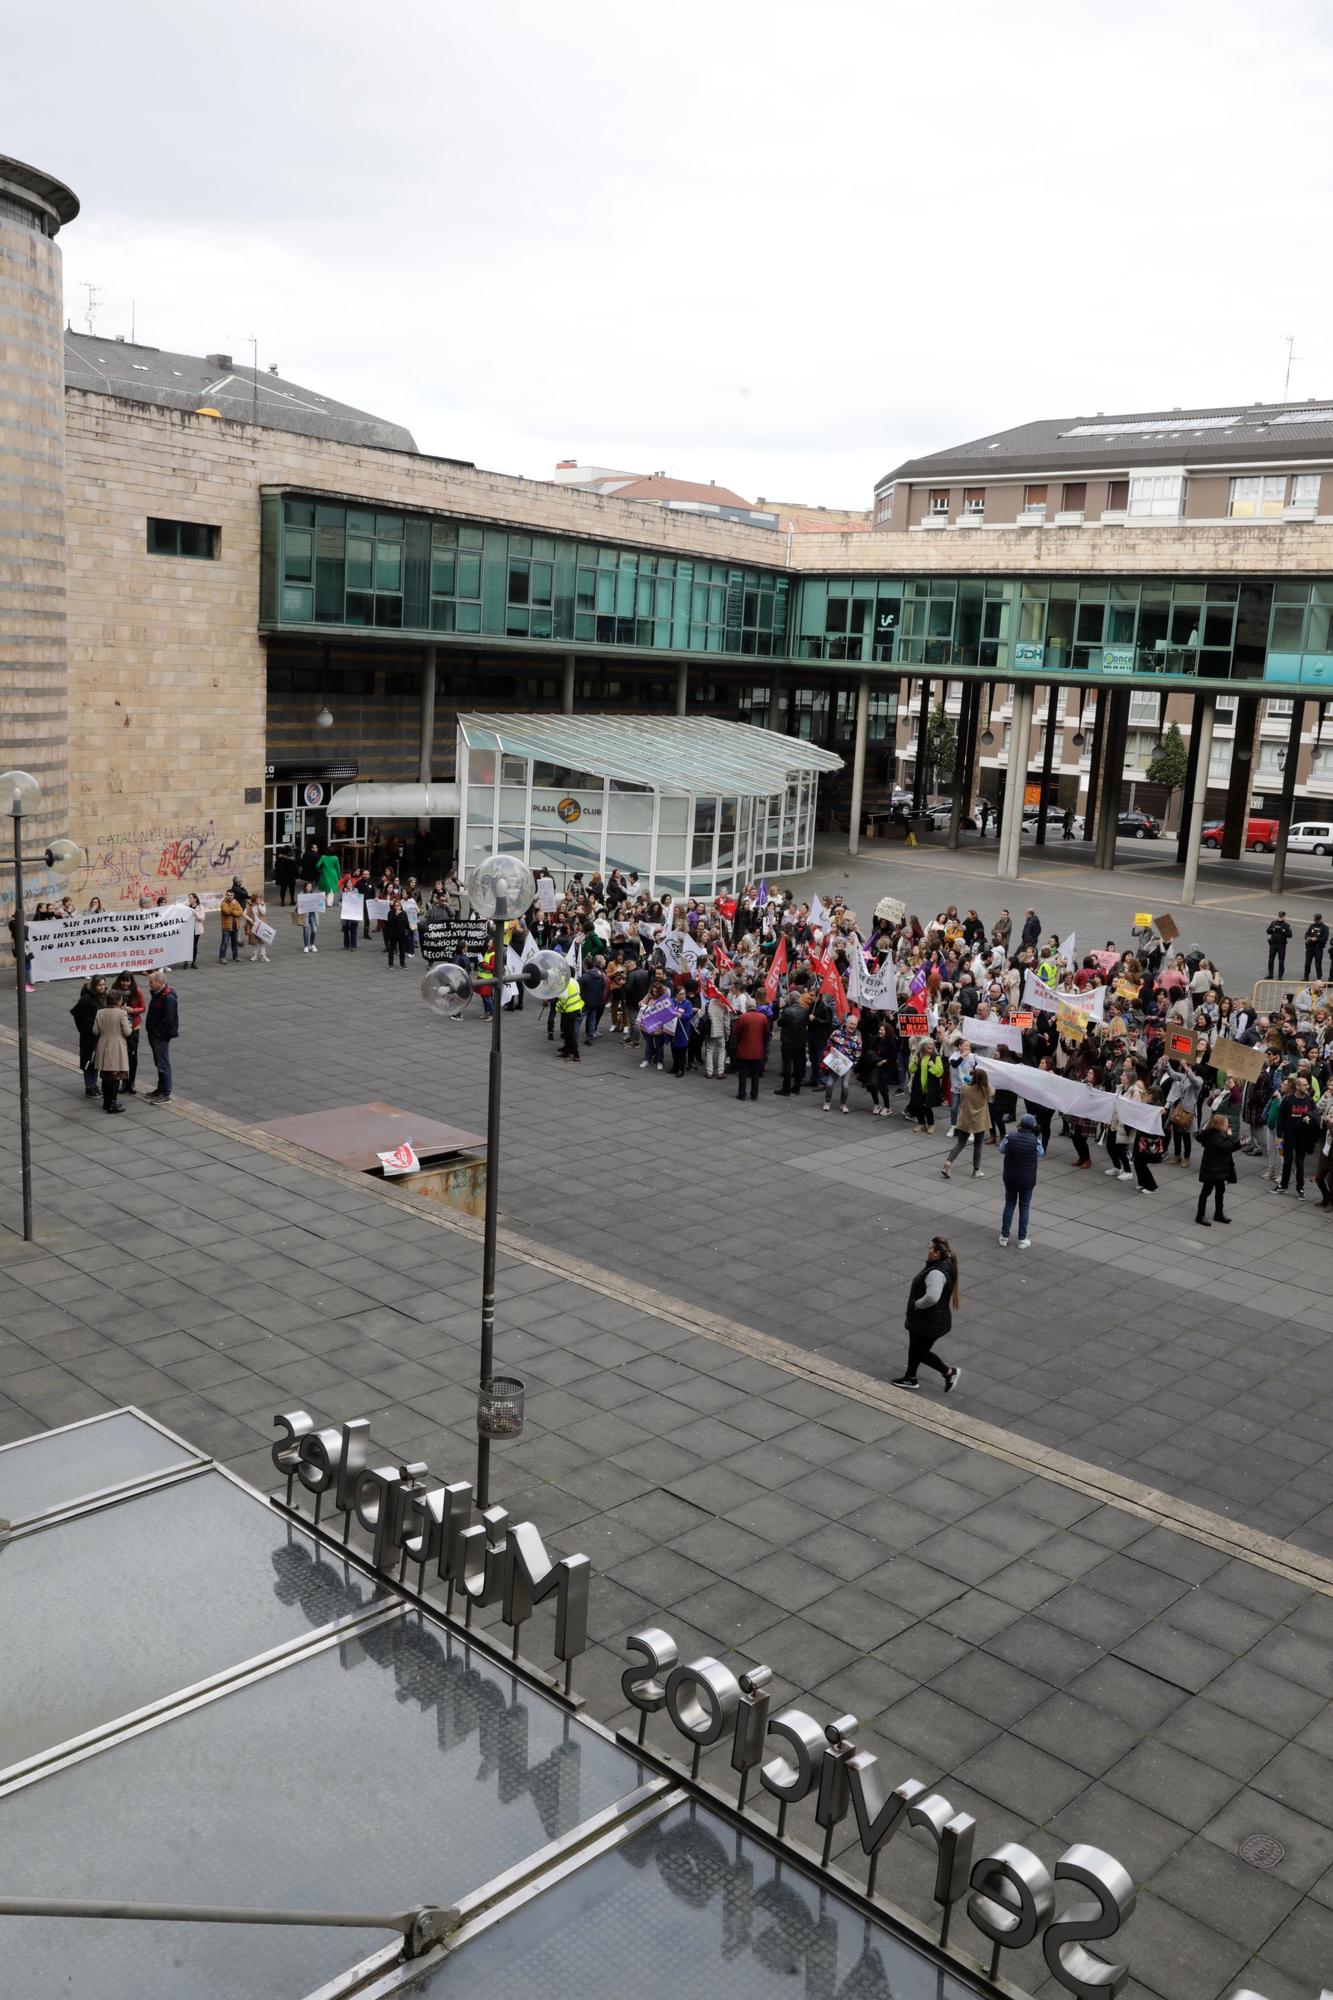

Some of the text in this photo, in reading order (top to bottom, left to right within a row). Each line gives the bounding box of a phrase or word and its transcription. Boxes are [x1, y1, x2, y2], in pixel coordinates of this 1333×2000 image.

[532, 804, 556, 813] PLAZA
[582, 807, 602, 815] CLUB
[62, 911, 162, 928] SIN MANTENIMIENTO,
[32, 934, 50, 942] SIN
[123, 924, 140, 932] SIN
[40, 943, 54, 951] NO
[79, 936, 119, 946] CALIDAD
[122, 929, 181, 942] ASISTENCIAL
[129, 949, 147, 957] DEL
[149, 947, 164, 955] ERA
[69, 959, 154, 972] CPR CLARA FERRER
